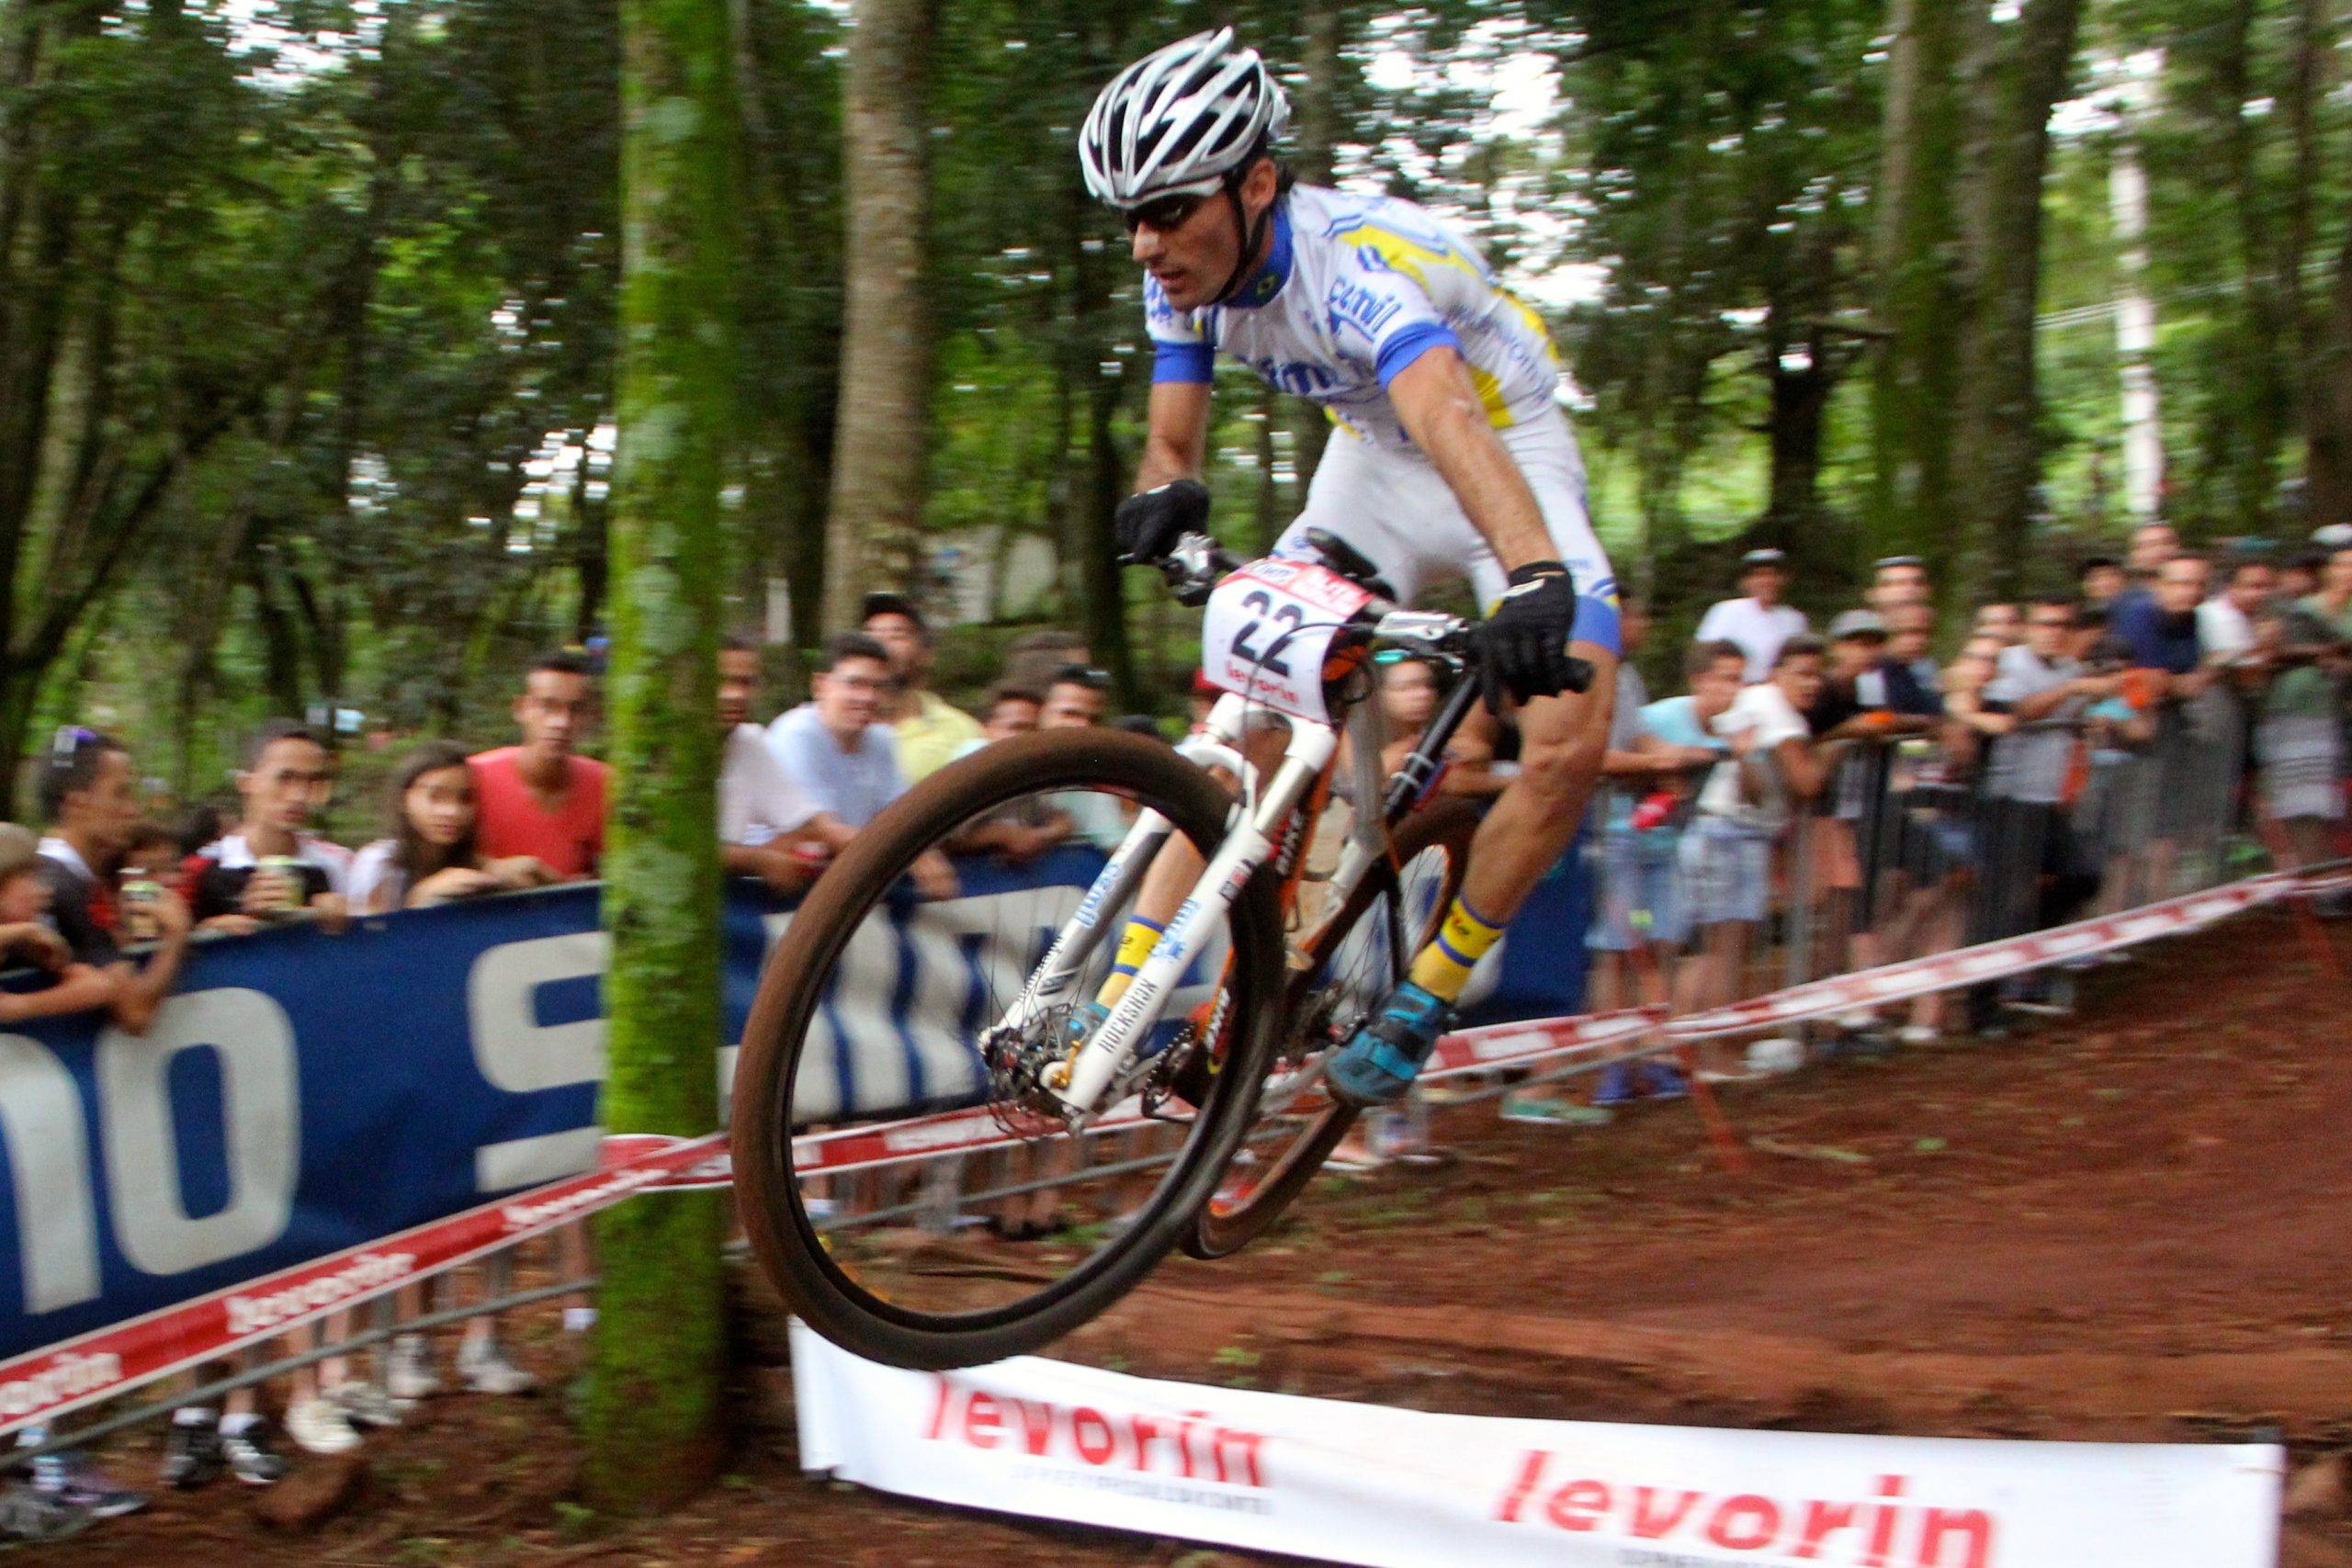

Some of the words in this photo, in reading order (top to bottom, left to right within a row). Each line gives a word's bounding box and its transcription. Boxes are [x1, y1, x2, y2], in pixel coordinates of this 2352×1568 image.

[1230, 590, 1304, 678] 22
[927, 1372, 1262, 1487] levorin
[1495, 1449, 1994, 1568] levorin
